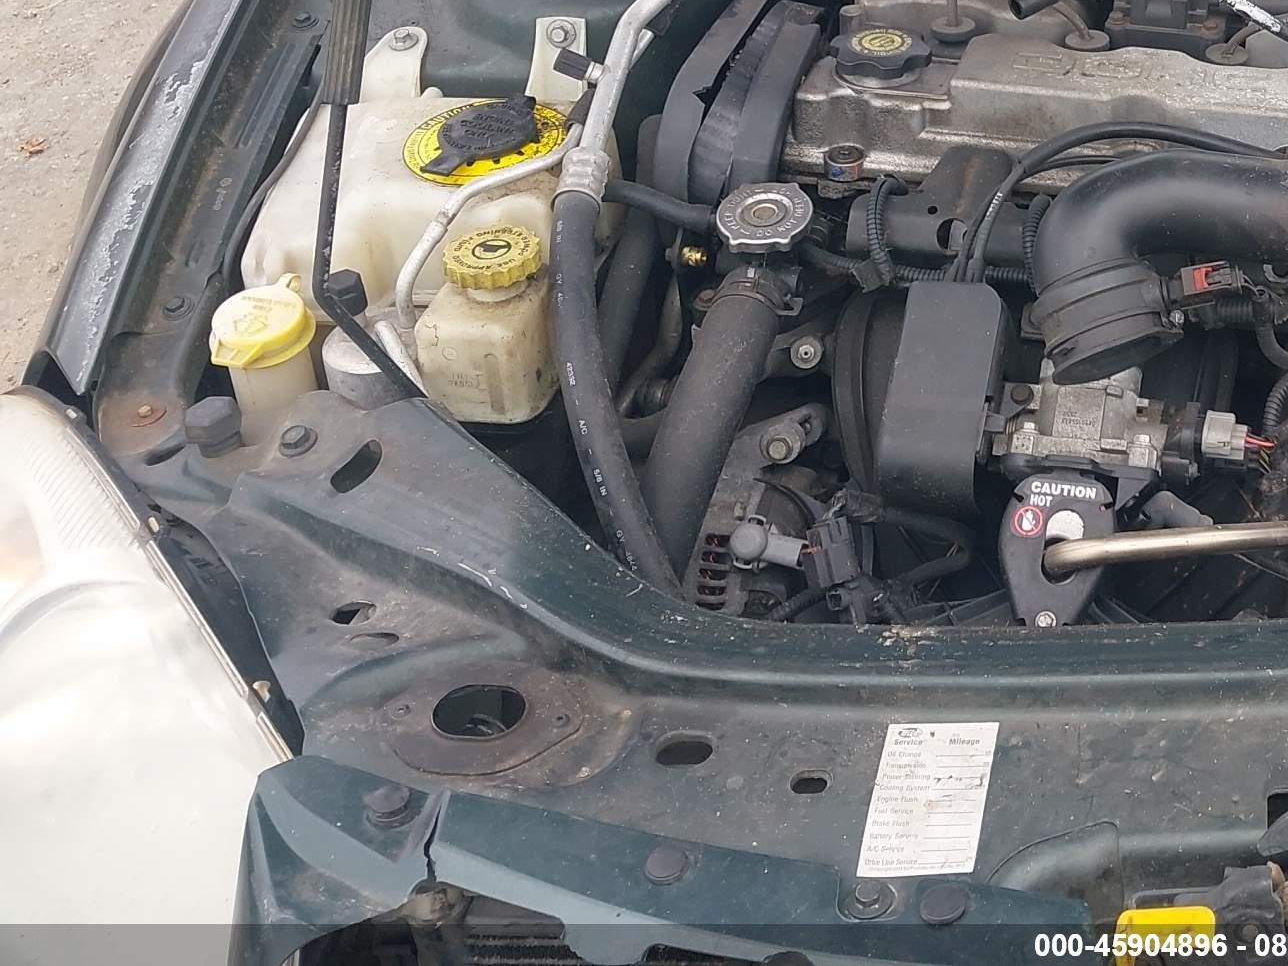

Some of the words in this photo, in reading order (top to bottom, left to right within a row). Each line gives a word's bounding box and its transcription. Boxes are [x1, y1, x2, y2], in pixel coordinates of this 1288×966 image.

[1031, 481, 1097, 500] CAUTION
[1029, 494, 1053, 507] HOT
[894, 738, 923, 746] Service
[949, 738, 980, 746] Mileage
[898, 751, 922, 759] Change
[905, 785, 930, 793] System
[876, 795, 899, 804] Engine
[900, 795, 919, 803] Flush
[864, 858, 880, 866] Drive
[896, 858, 918, 866] Service
